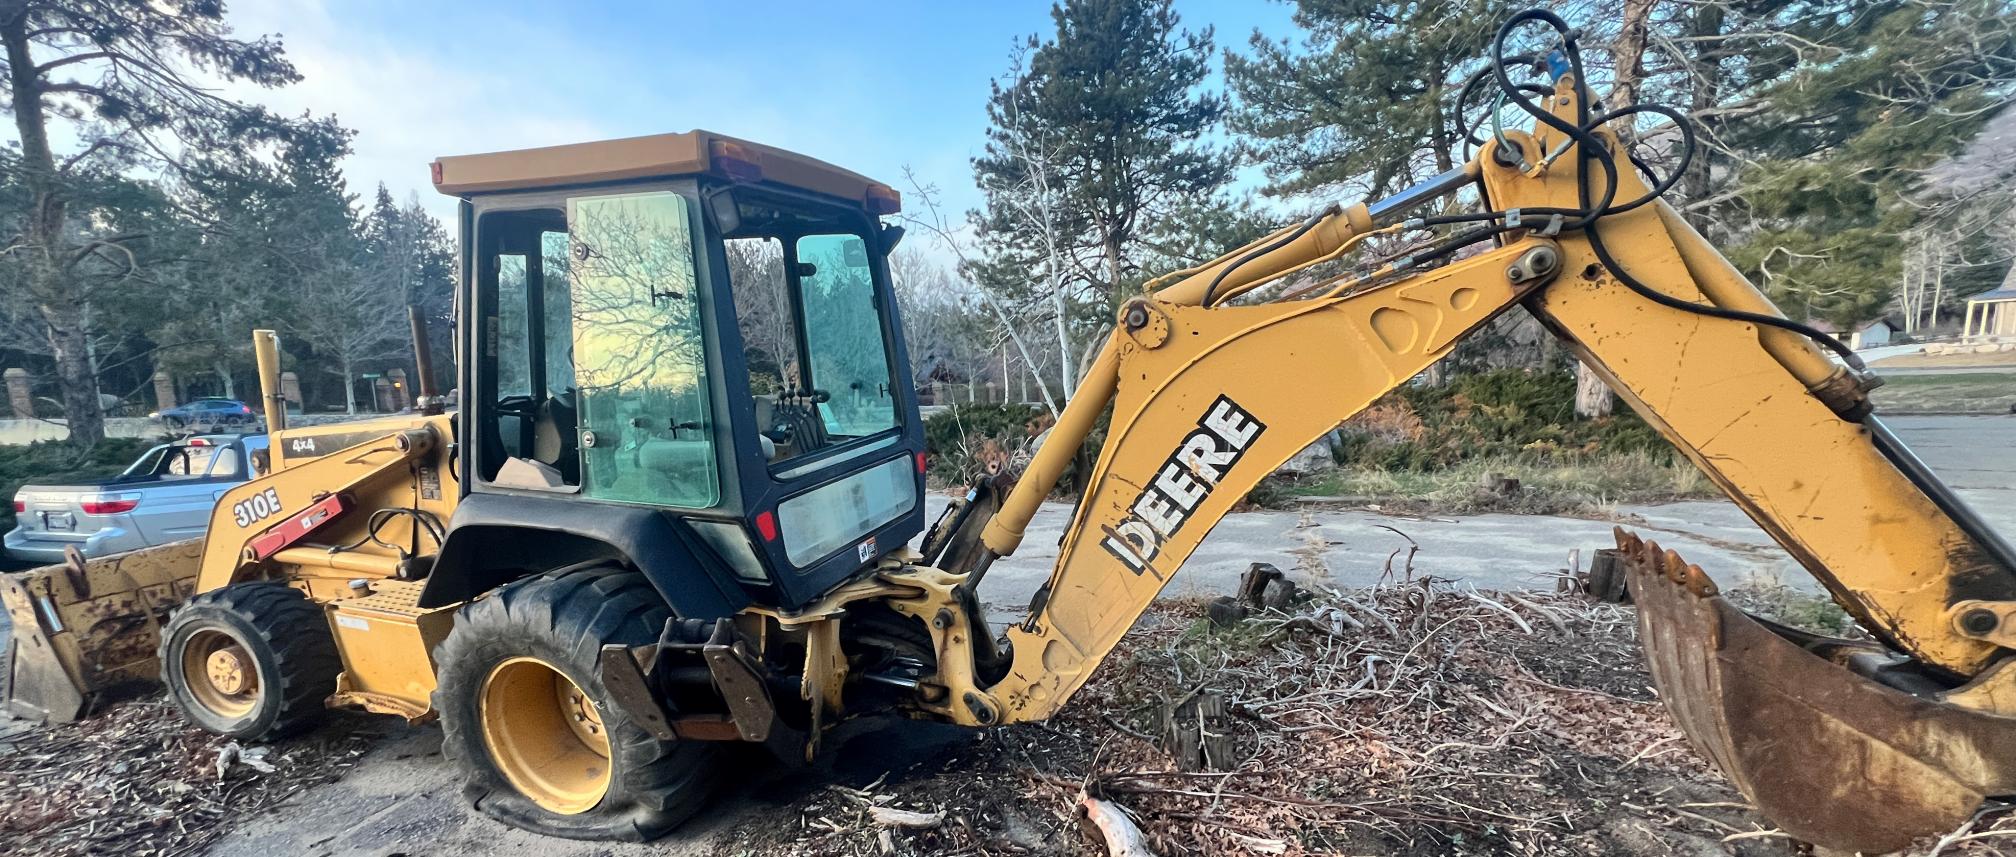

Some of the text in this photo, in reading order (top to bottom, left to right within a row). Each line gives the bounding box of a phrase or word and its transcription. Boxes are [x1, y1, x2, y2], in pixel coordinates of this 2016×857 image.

[292, 438, 315, 452] 4x4
[1103, 398, 1263, 571] DEERE
[233, 487, 282, 528] 310E
